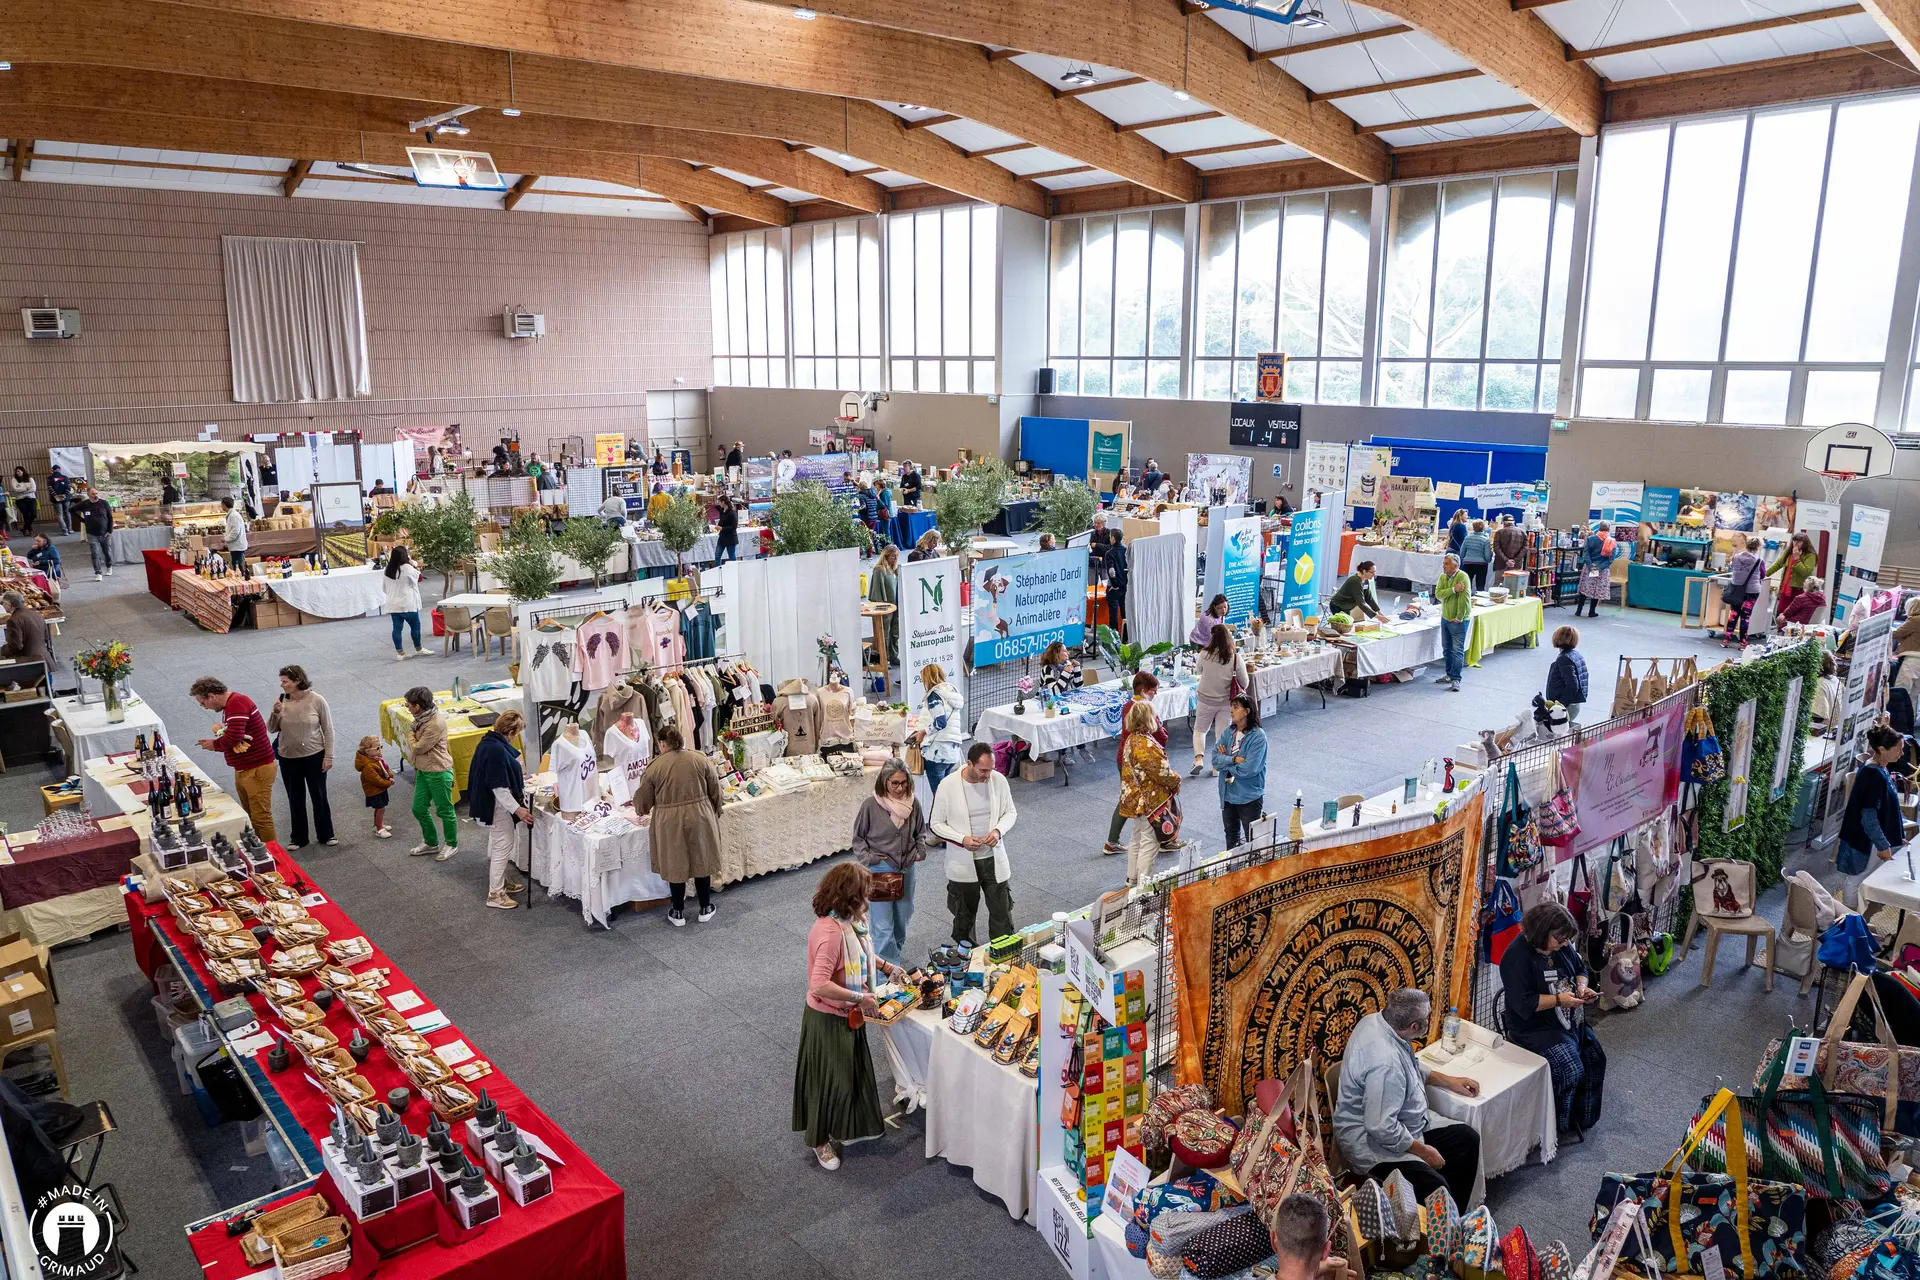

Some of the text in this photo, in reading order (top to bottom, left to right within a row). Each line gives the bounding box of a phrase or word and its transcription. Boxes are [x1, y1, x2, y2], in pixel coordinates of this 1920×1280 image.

[1231, 418, 1298, 430] LOCAUX VISITEURS
[1015, 566, 1082, 590] Stéphanie Dardi
[1015, 589, 1067, 608] Naturopathe
[1015, 608, 1061, 627] Animalière
[910, 633, 955, 650] Naturopathe
[913, 659, 921, 668] 06
[939, 654, 945, 662] 15
[946, 653, 954, 661] 28
[1068, 1200, 1080, 1212] BEST
